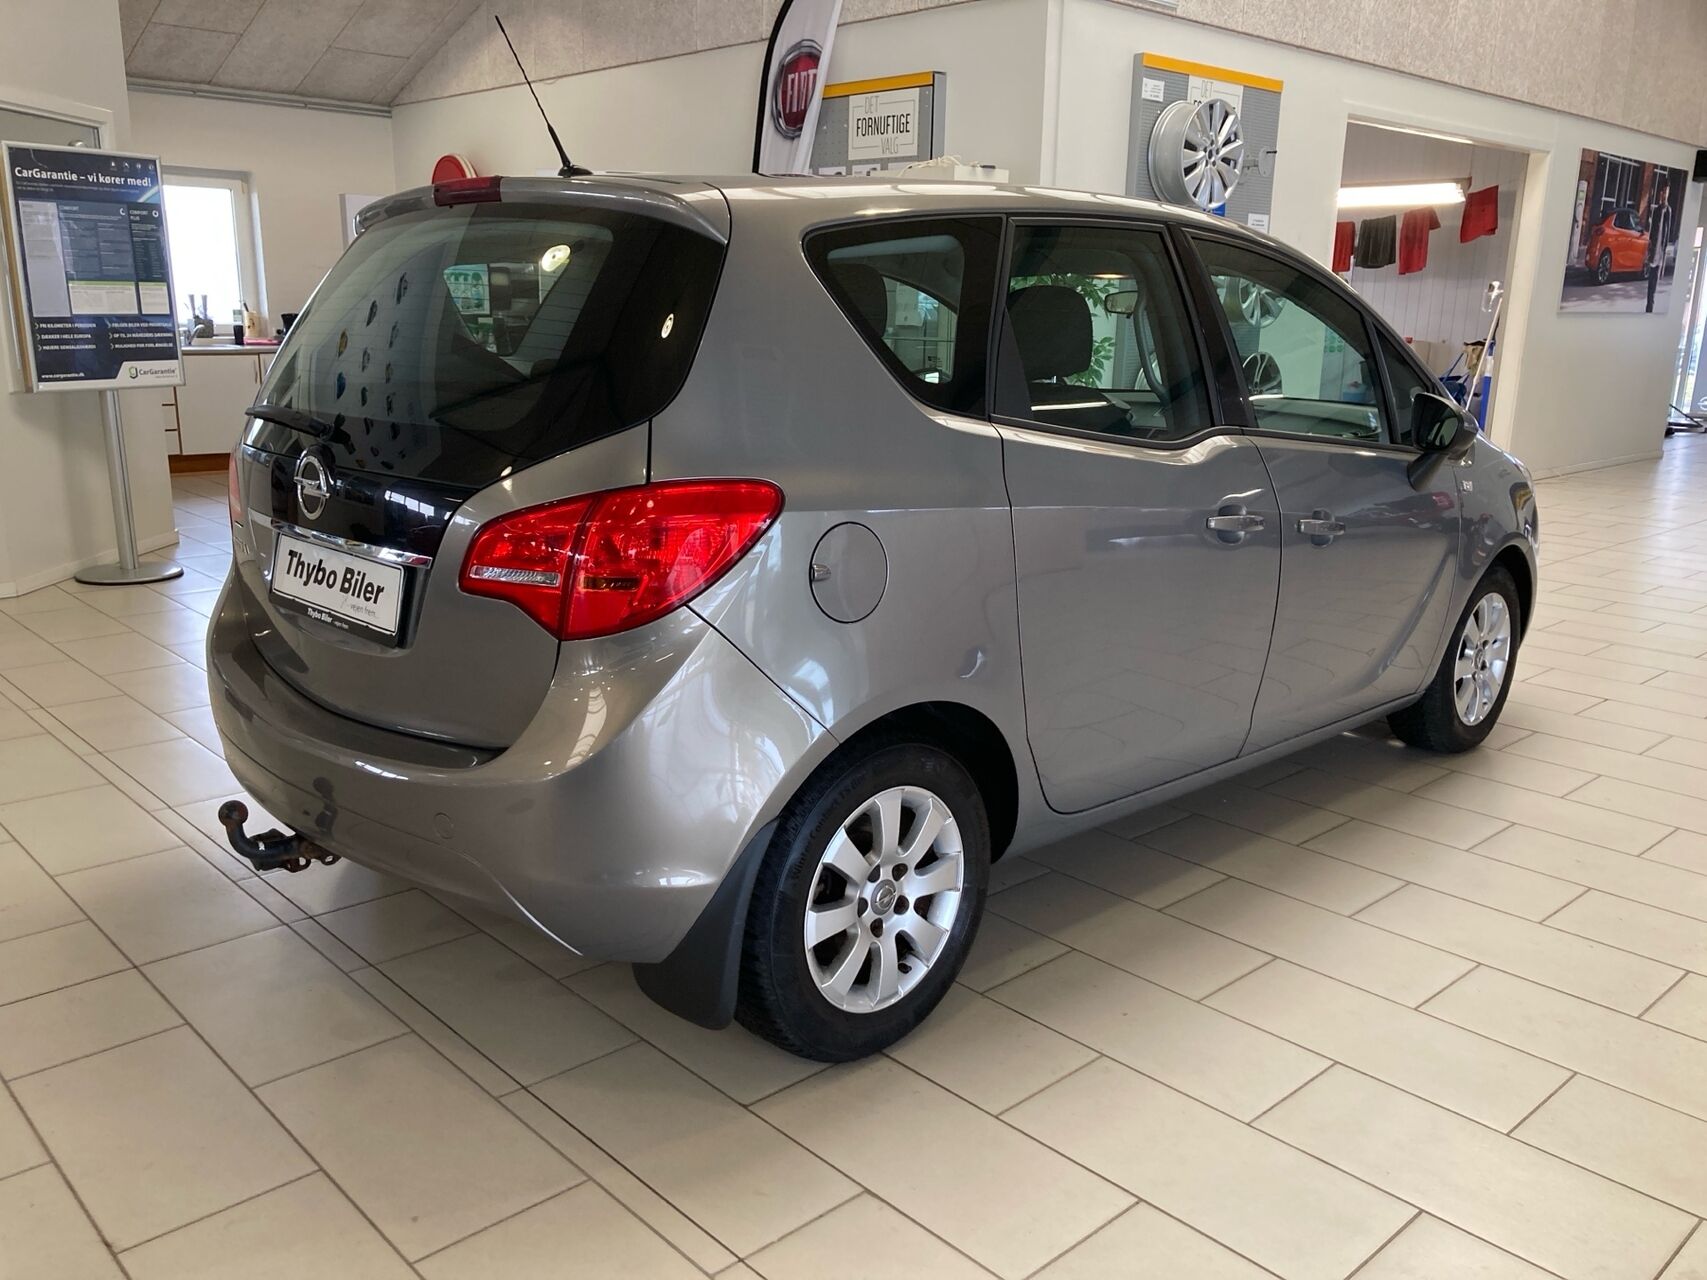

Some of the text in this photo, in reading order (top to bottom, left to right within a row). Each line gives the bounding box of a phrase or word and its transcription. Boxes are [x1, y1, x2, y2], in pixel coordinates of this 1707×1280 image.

[786, 68, 818, 115] FIAT
[864, 95, 880, 114] DET
[856, 113, 911, 138] FORNUFTIGE
[880, 136, 899, 155] VALG
[14, 166, 78, 181] CarGarantie
[87, 173, 97, 183] vi
[98, 173, 125, 185] kører
[127, 177, 152, 187] med!
[138, 368, 176, 376] CarGarantie
[286, 549, 385, 604] Thybo Biler
[307, 607, 333, 623] Thybo Biler
